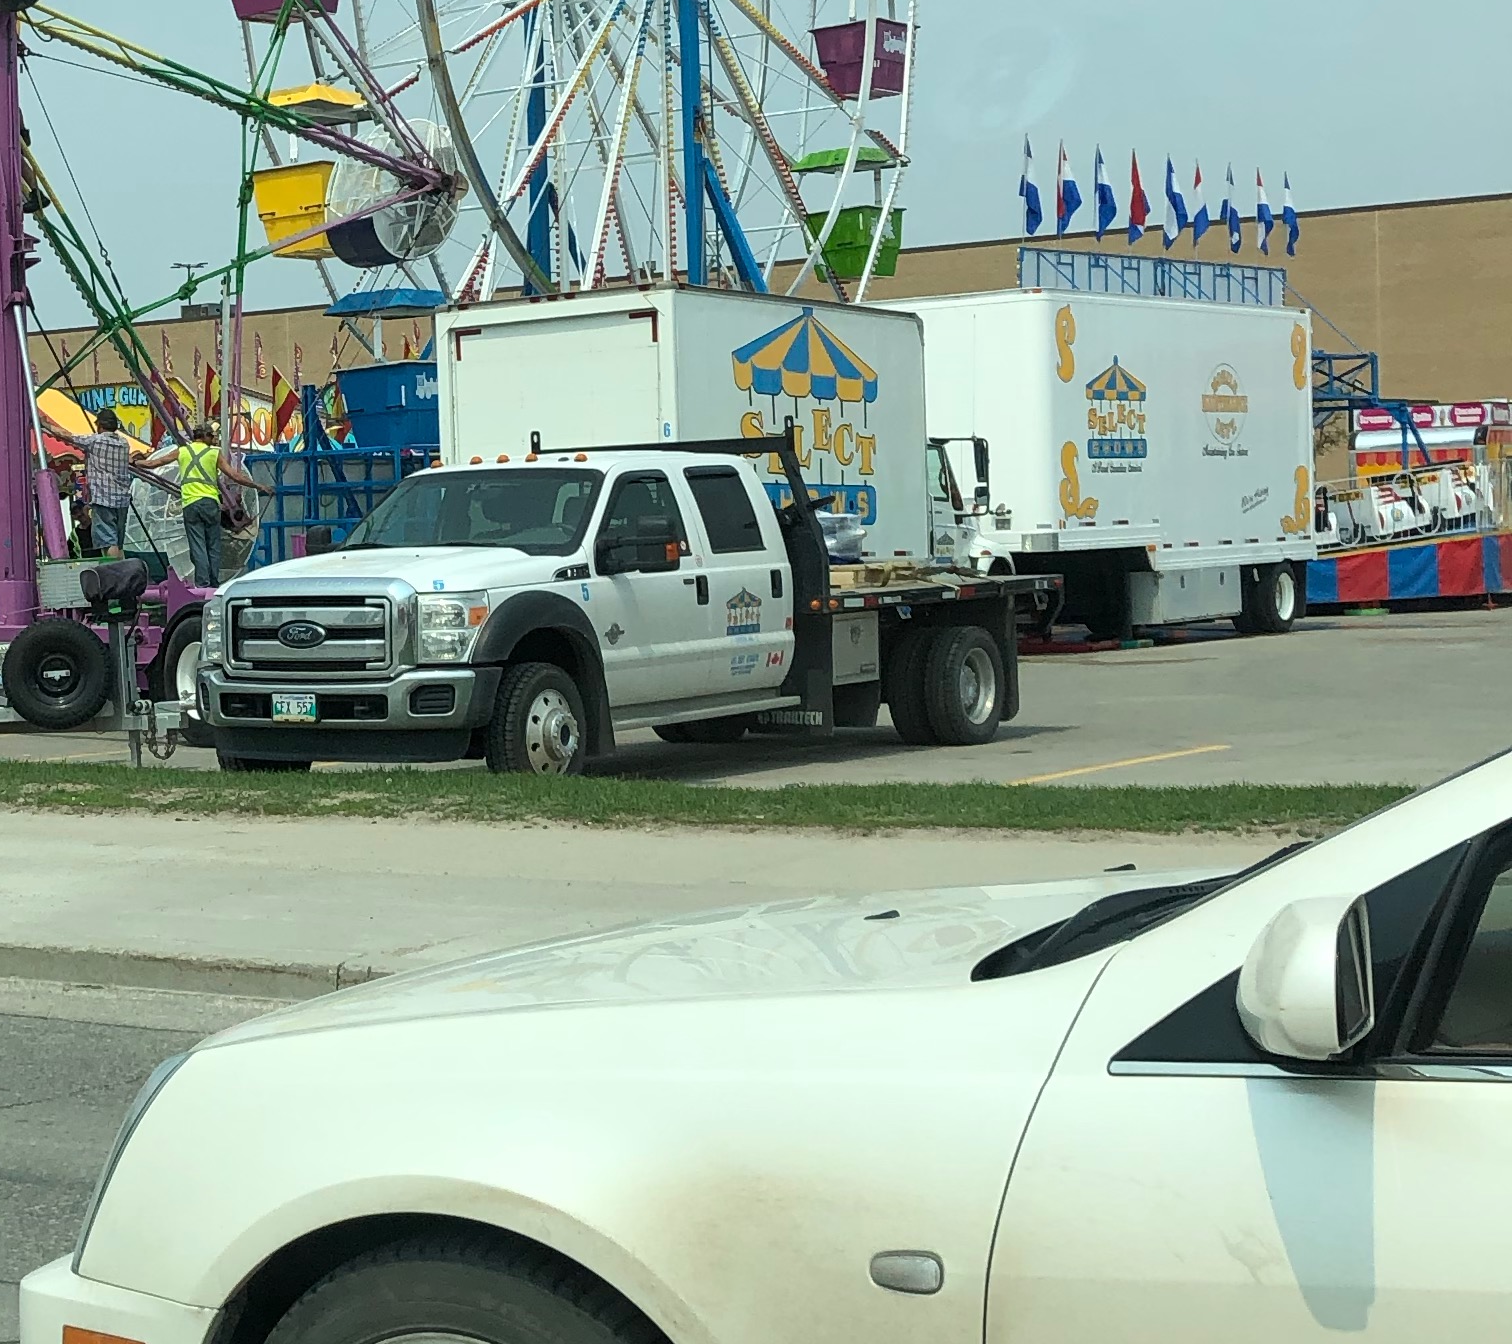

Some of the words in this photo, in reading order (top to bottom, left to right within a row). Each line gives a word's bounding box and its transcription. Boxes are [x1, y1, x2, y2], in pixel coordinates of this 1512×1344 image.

[1089, 404, 1146, 436] SELECT
[663, 422, 671, 438] 6
[580, 582, 590, 602] 5
[286, 626, 313, 641] Ford
